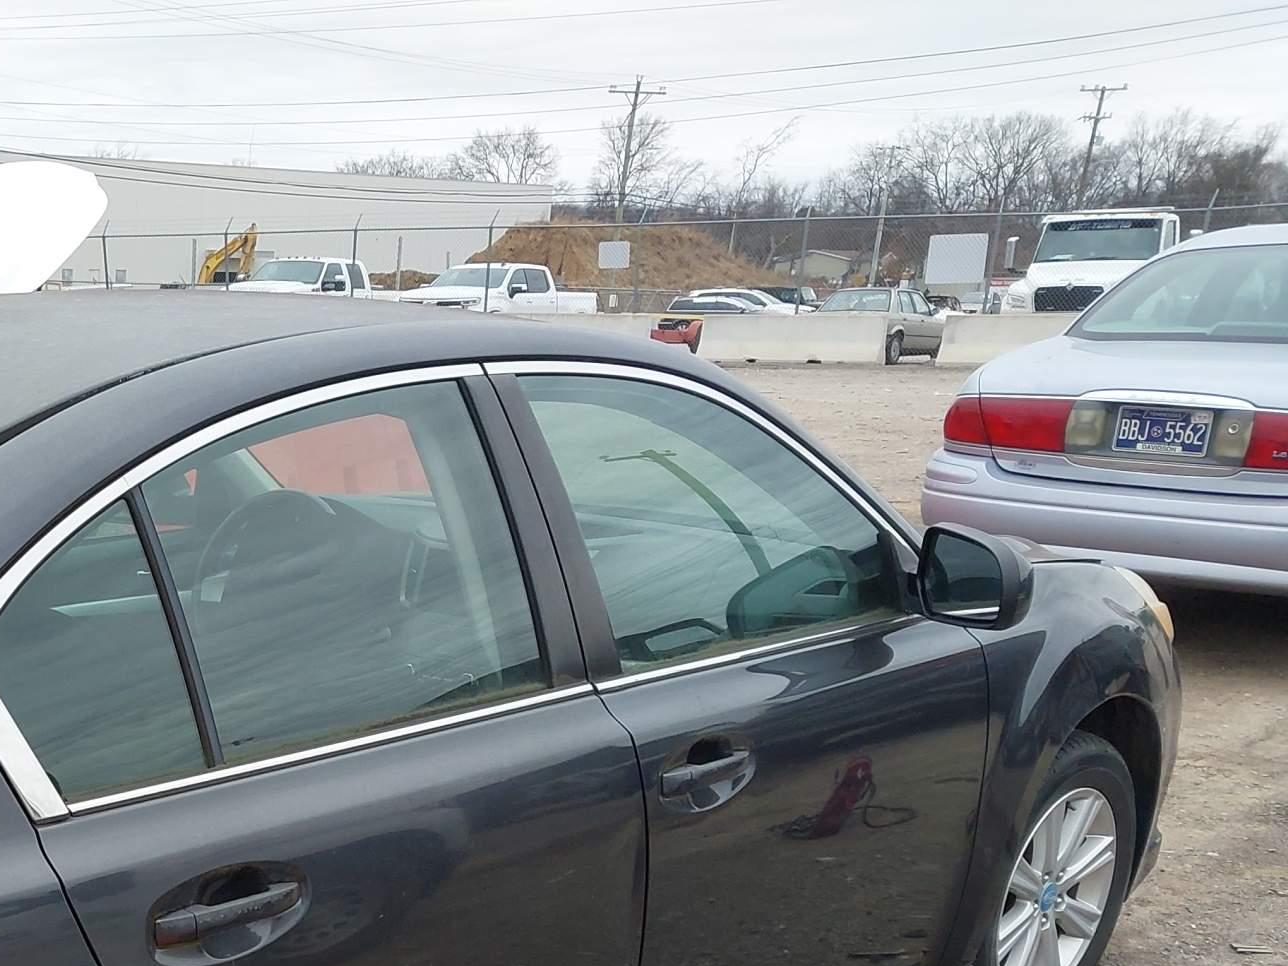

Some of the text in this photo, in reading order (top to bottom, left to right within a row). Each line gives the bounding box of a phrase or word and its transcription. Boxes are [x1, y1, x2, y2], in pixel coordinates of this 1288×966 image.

[1118, 418, 1206, 445] BBJ 5562
[1141, 443, 1178, 453] DAVIDSON
